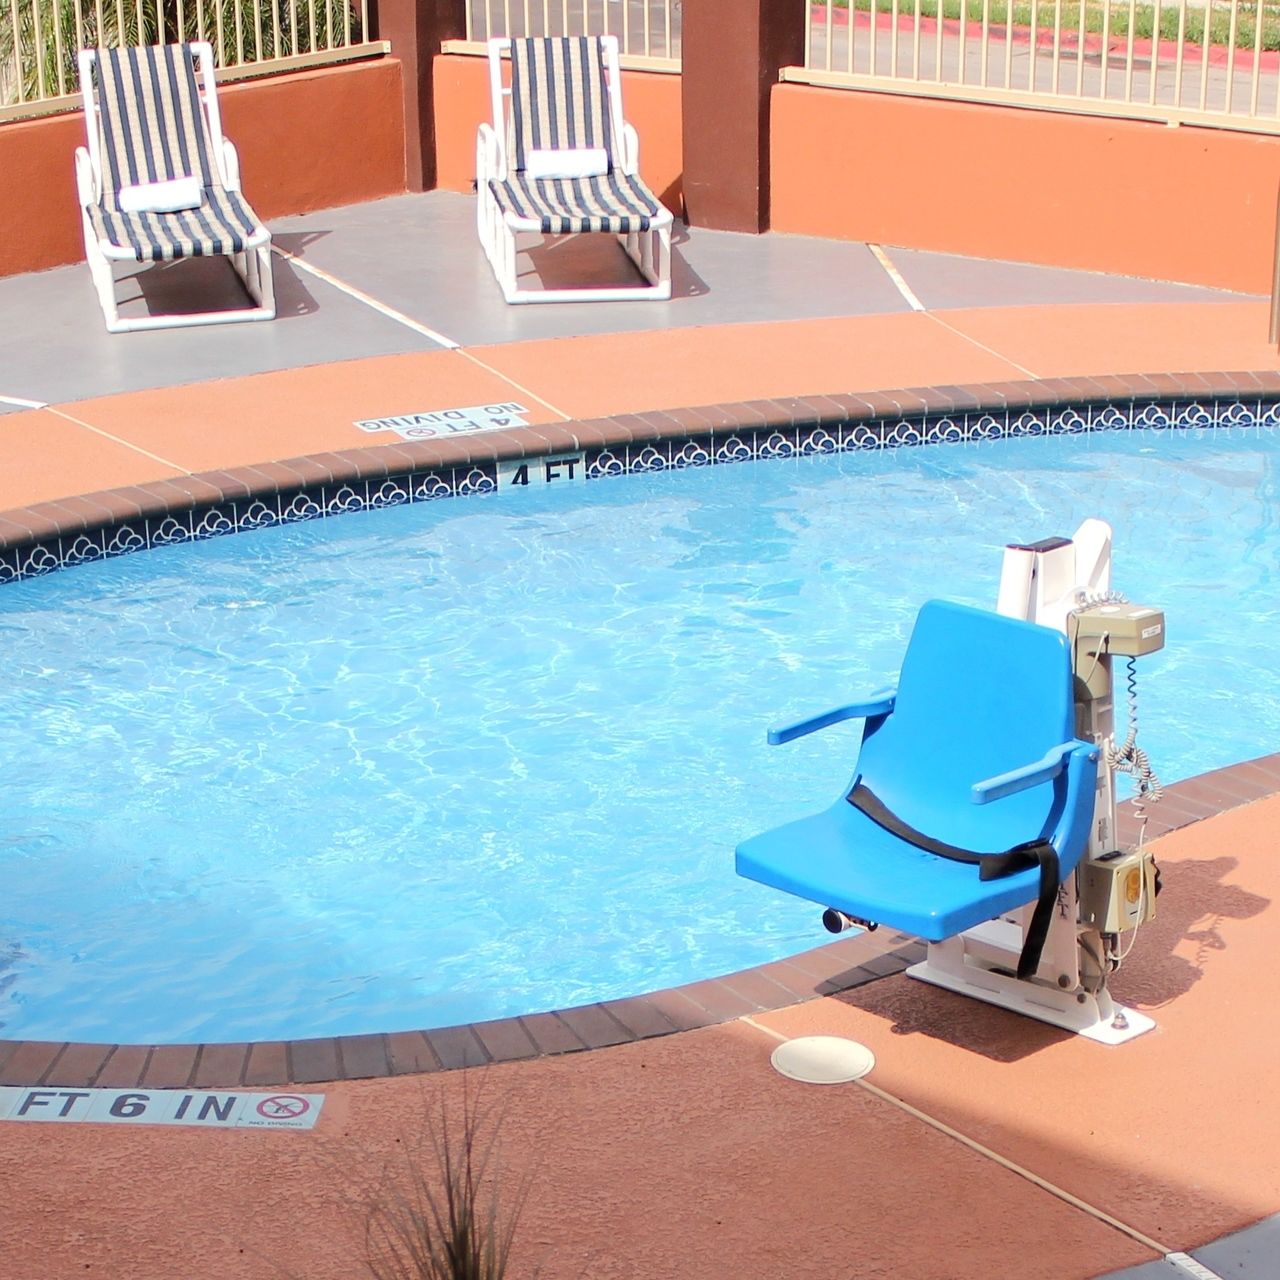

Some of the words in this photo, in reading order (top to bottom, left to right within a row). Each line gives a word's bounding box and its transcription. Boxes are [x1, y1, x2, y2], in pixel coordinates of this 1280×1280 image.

[484, 403, 524, 415] NO
[359, 410, 466, 429] DIVING
[490, 417, 511, 427] 4
[442, 422, 483, 433] FT
[511, 464, 529, 485] 4
[546, 458, 580, 483] FT
[17, 1091, 91, 1117] FT
[109, 1094, 150, 1118] 6
[174, 1095, 237, 1121] IN
